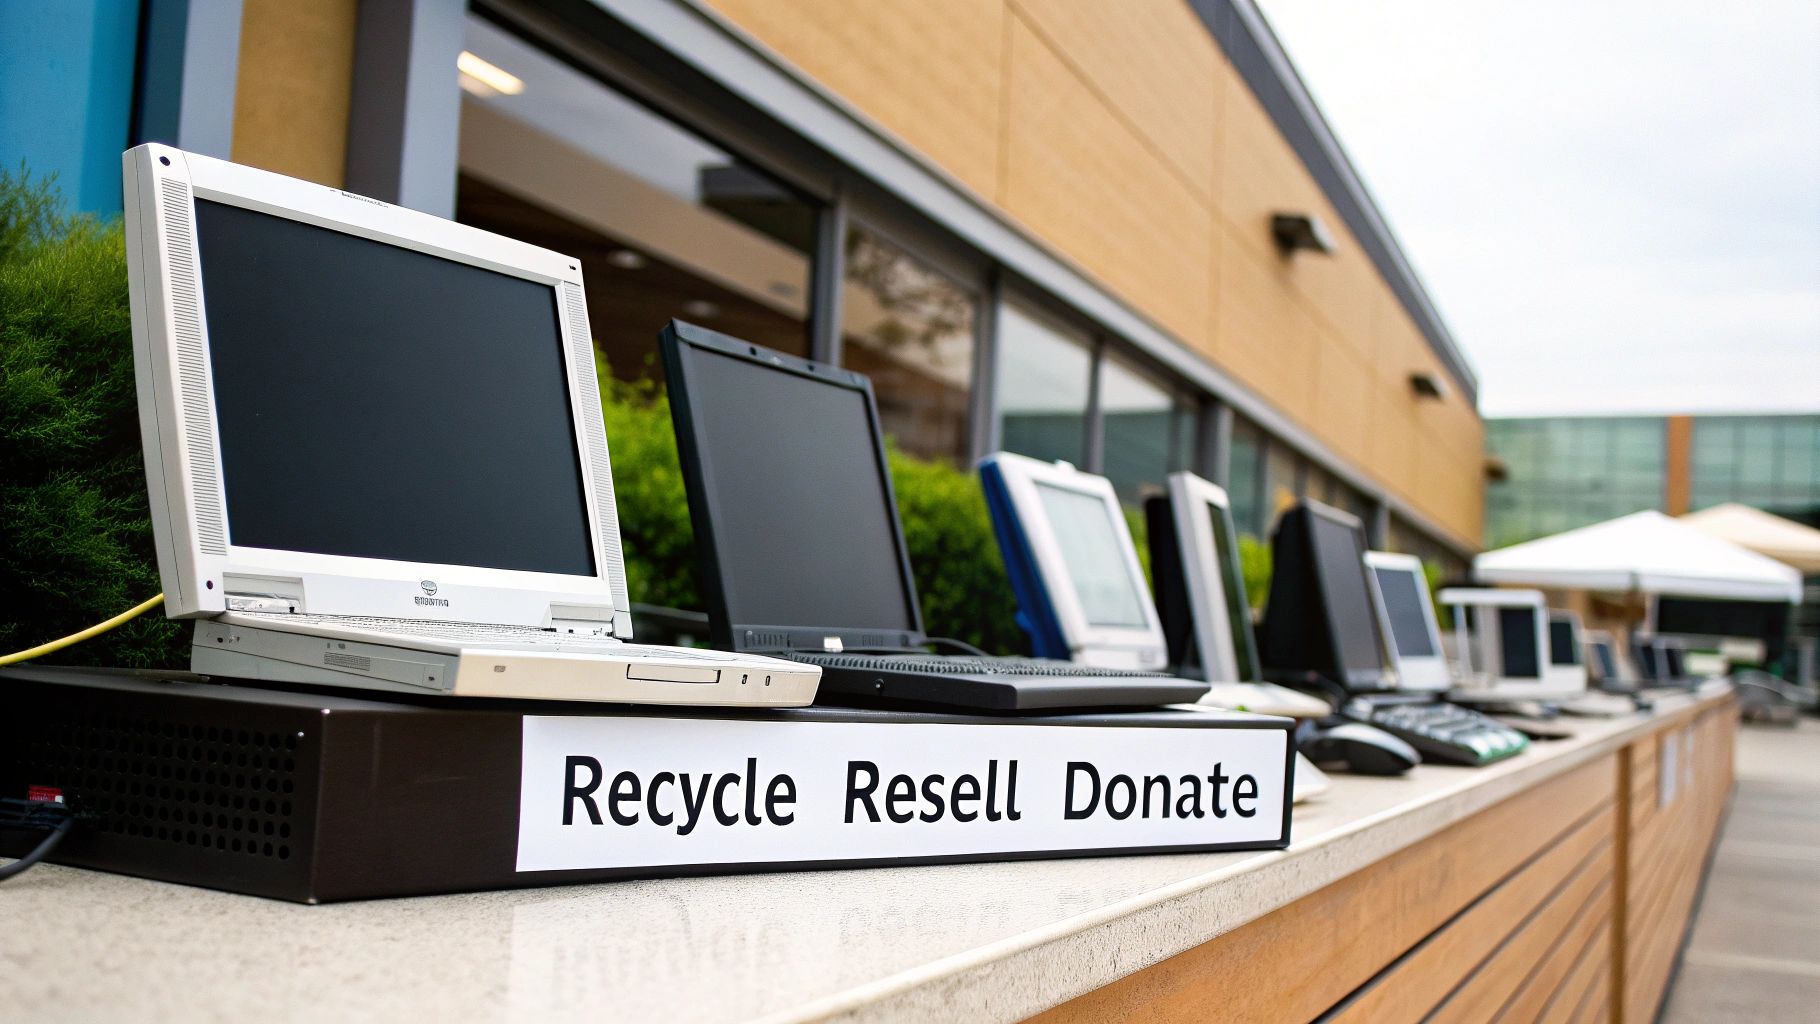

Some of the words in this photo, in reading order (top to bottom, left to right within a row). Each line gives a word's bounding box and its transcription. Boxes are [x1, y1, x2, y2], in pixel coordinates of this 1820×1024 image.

[563, 756, 797, 835] Recycle
[844, 759, 1021, 824] Resell
[1063, 761, 1258, 821] Donate
